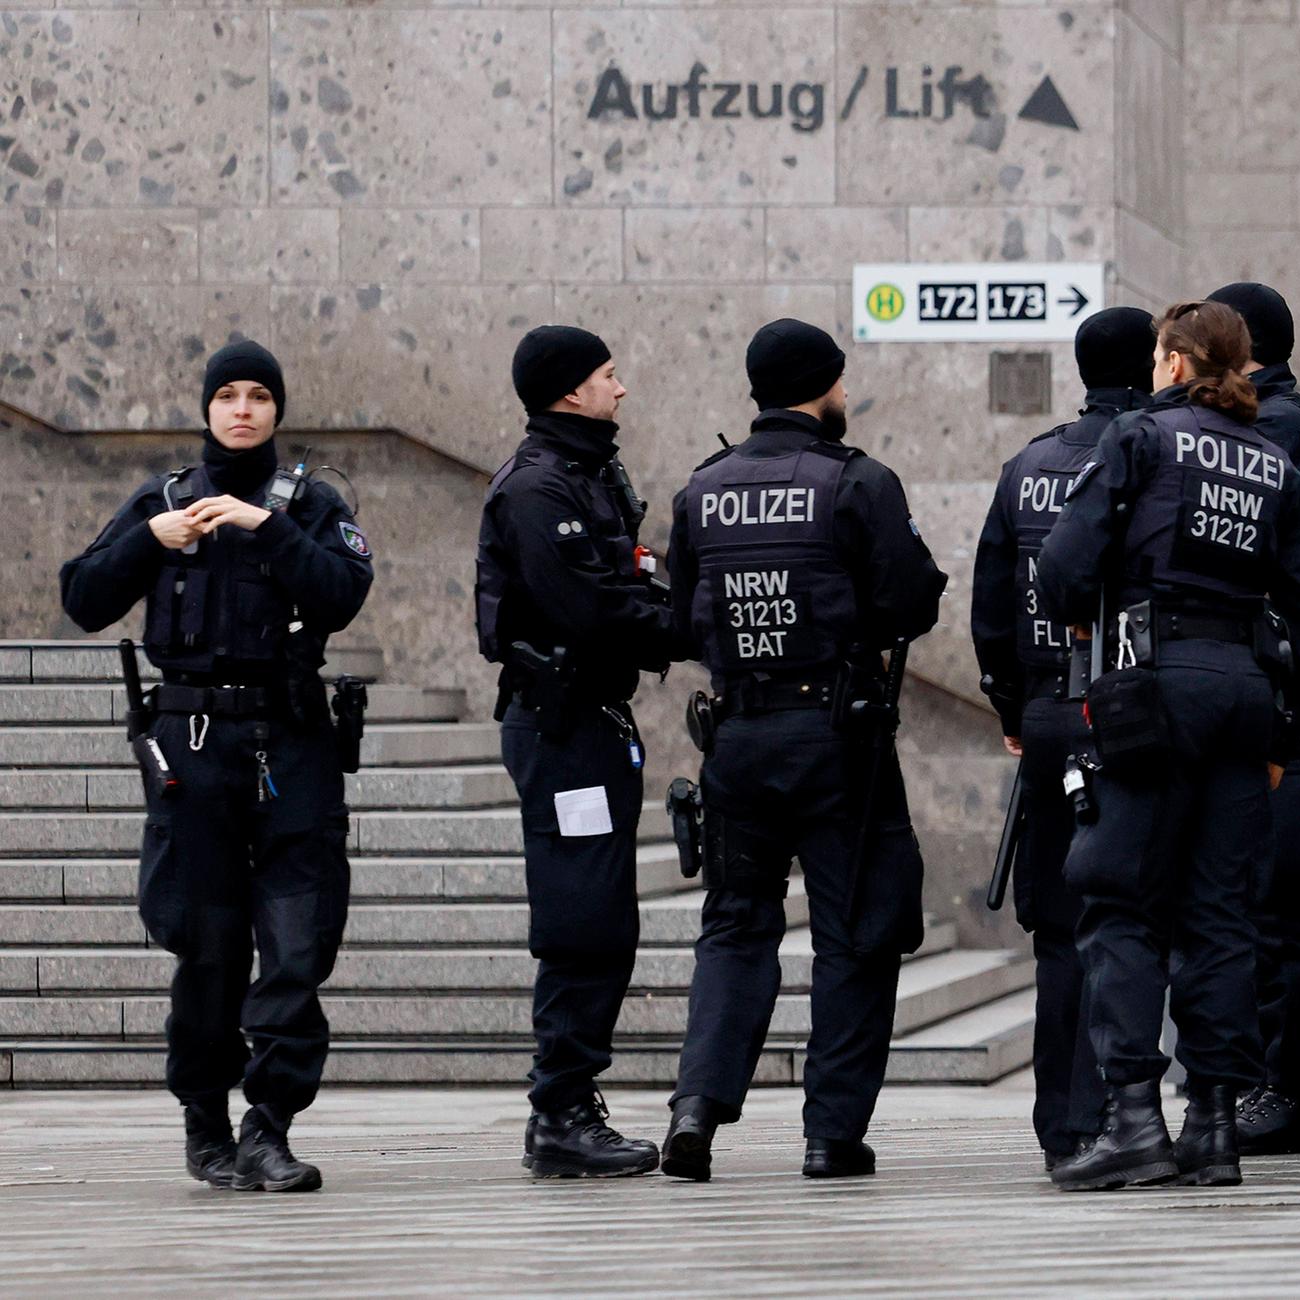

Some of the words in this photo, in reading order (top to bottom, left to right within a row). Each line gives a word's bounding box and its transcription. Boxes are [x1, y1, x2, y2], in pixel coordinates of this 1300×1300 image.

[586, 64, 826, 134] Aufzug
[840, 65, 869, 121] /
[885, 65, 993, 121] Lift
[919, 286, 976, 319] 172
[988, 286, 1046, 318] 173
[1175, 431, 1285, 491] POLIZEI
[701, 488, 815, 528] POLIZEI
[1018, 476, 1075, 513] POLI
[1200, 481, 1264, 520] NRW
[1190, 510, 1257, 552] 31212
[724, 570, 789, 598] NRW
[728, 599, 797, 628] 31213
[737, 631, 787, 658] BAT
